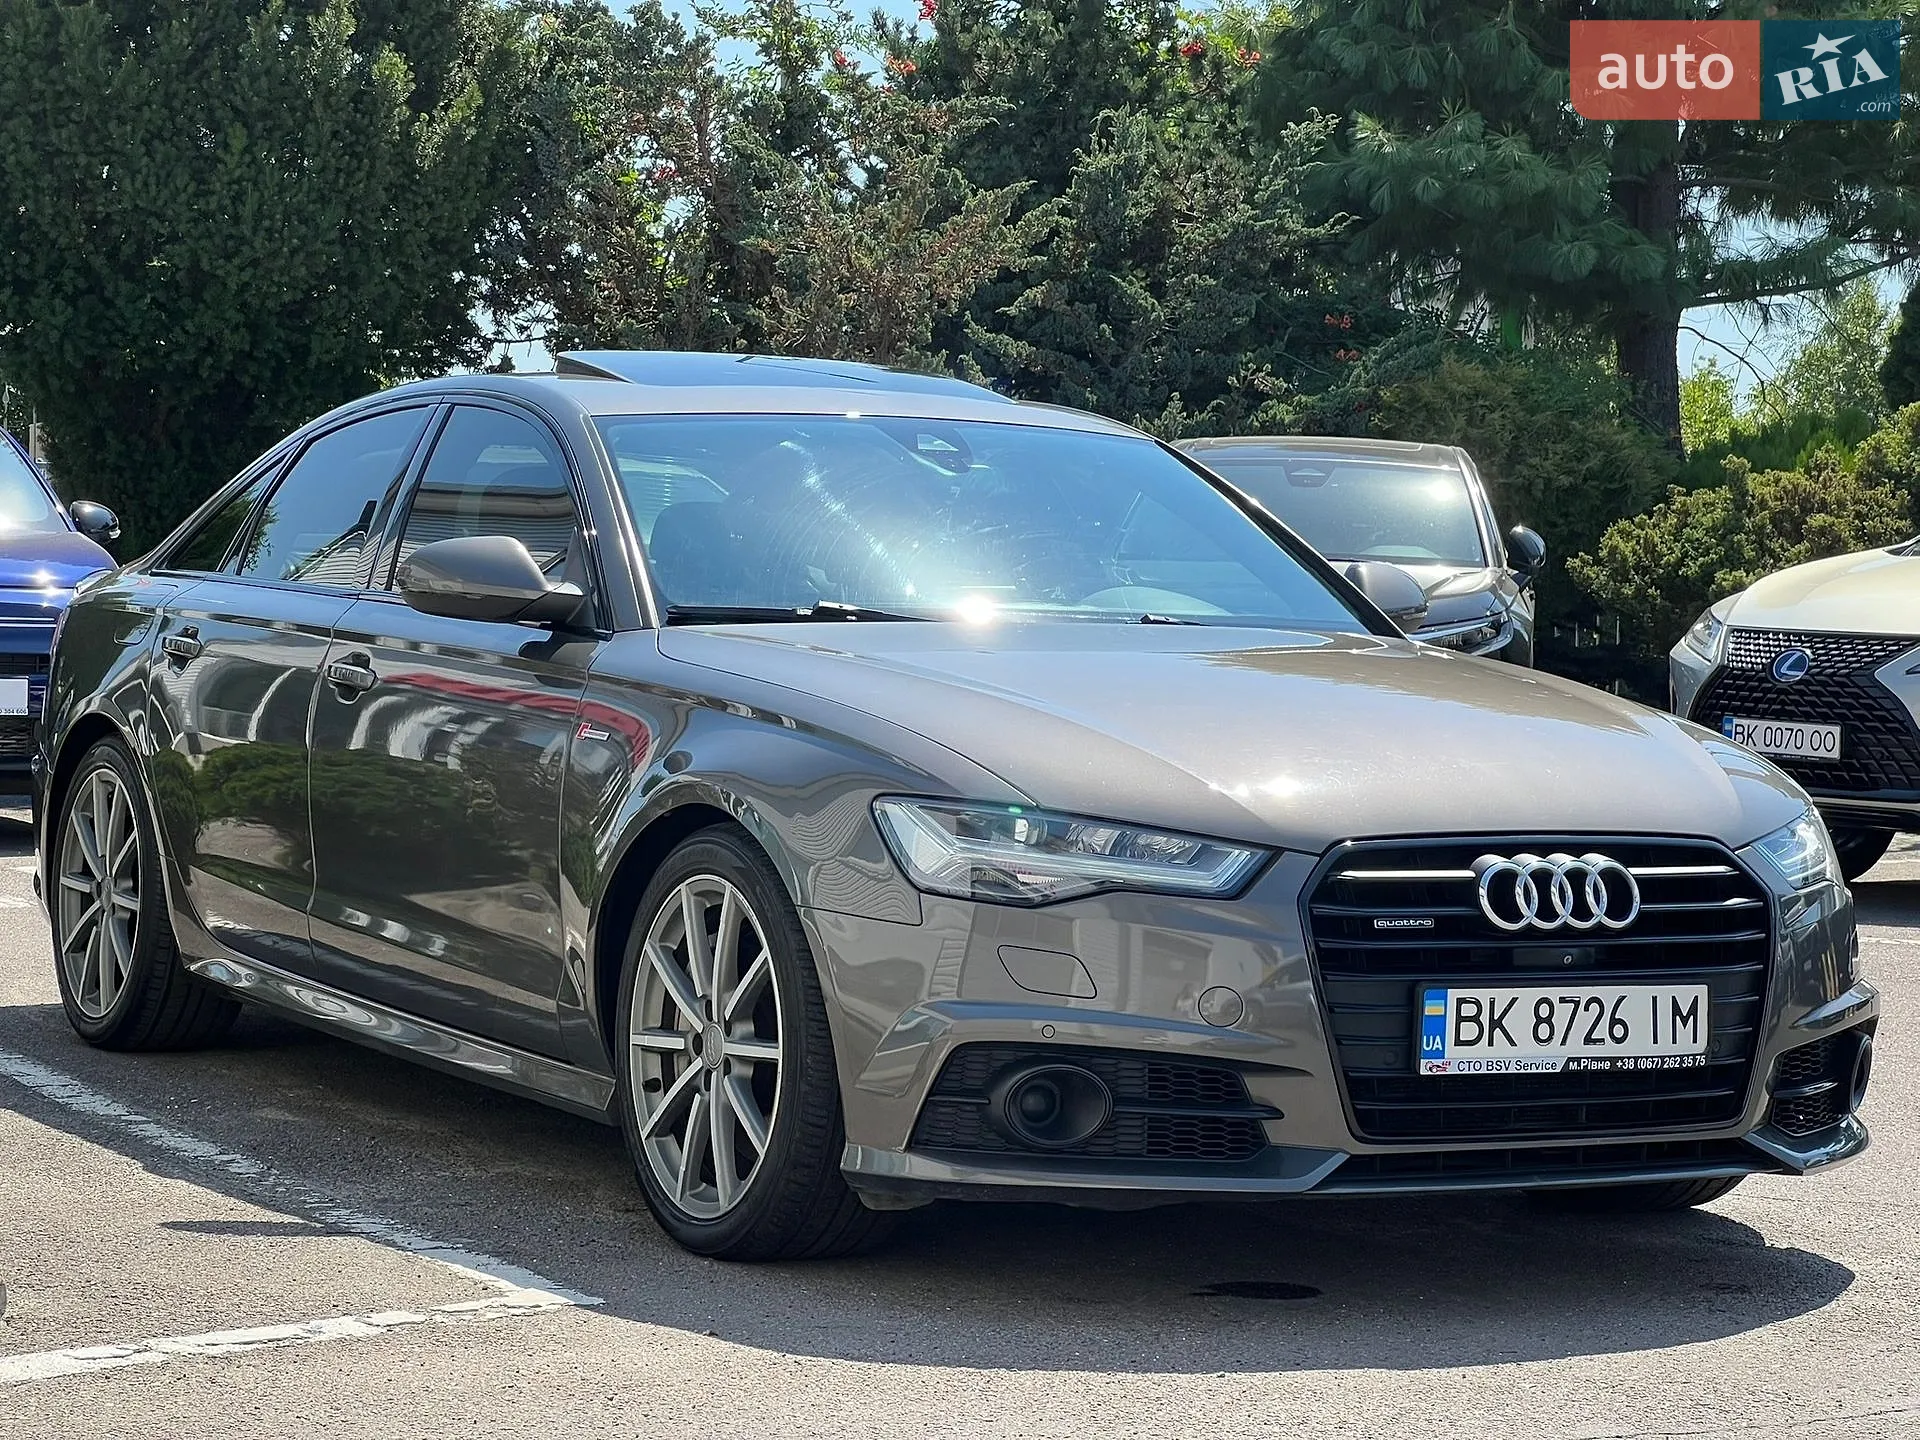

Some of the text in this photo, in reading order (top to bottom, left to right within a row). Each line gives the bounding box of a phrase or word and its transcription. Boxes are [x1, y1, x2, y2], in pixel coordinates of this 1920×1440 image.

[1734, 724, 1758, 746] BK
[1764, 726, 1804, 749] 0070
[1377, 920, 1432, 928] quattro
[1453, 995, 1698, 1047] BK 8726 IM
[1423, 1035, 1442, 1051] UA
[1486, 1060, 1511, 1072] BSV
[1514, 1059, 1557, 1071] Service
[1616, 1058, 1635, 1069] +38
[1637, 1057, 1661, 1069] (067)
[1663, 1056, 1680, 1068] 262
[1682, 1056, 1693, 1067] 35
[1695, 1055, 1706, 1066] 75
